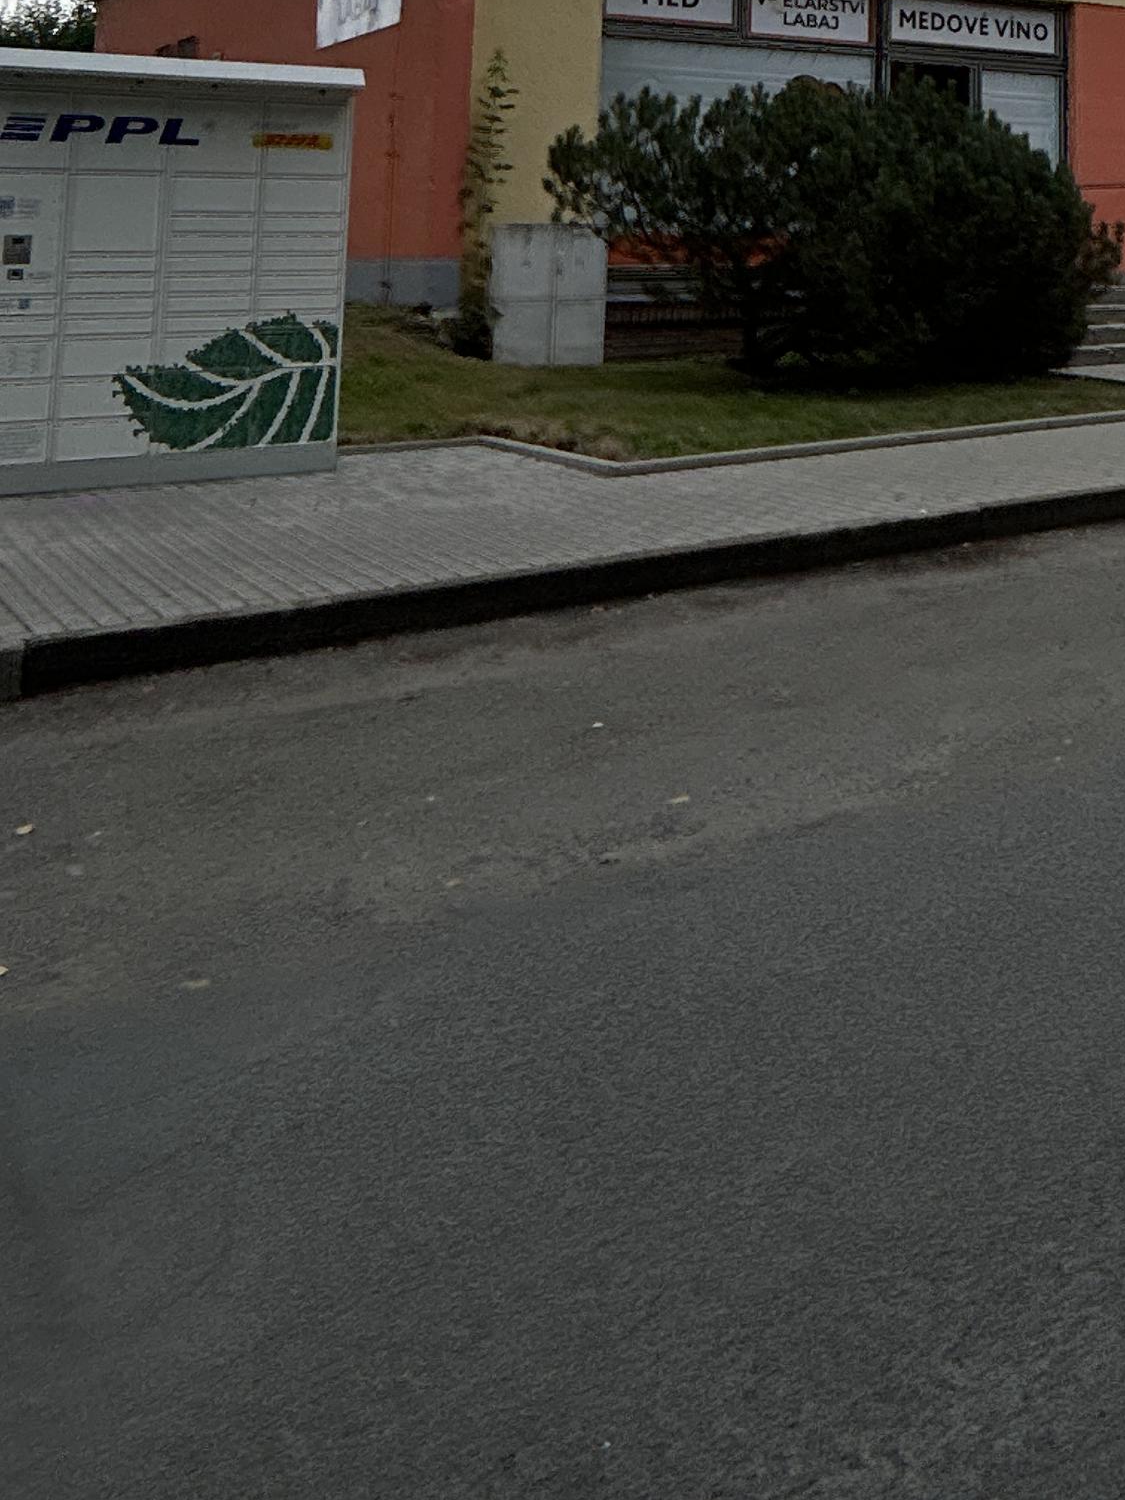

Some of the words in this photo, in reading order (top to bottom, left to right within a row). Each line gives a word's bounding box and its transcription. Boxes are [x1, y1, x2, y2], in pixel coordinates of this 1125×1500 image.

[783, 12, 839, 30] LABAJ
[899, 9, 990, 36] MEDOVÉ
[995, 15, 1048, 41] VÍNO
[50, 114, 200, 146] PPL
